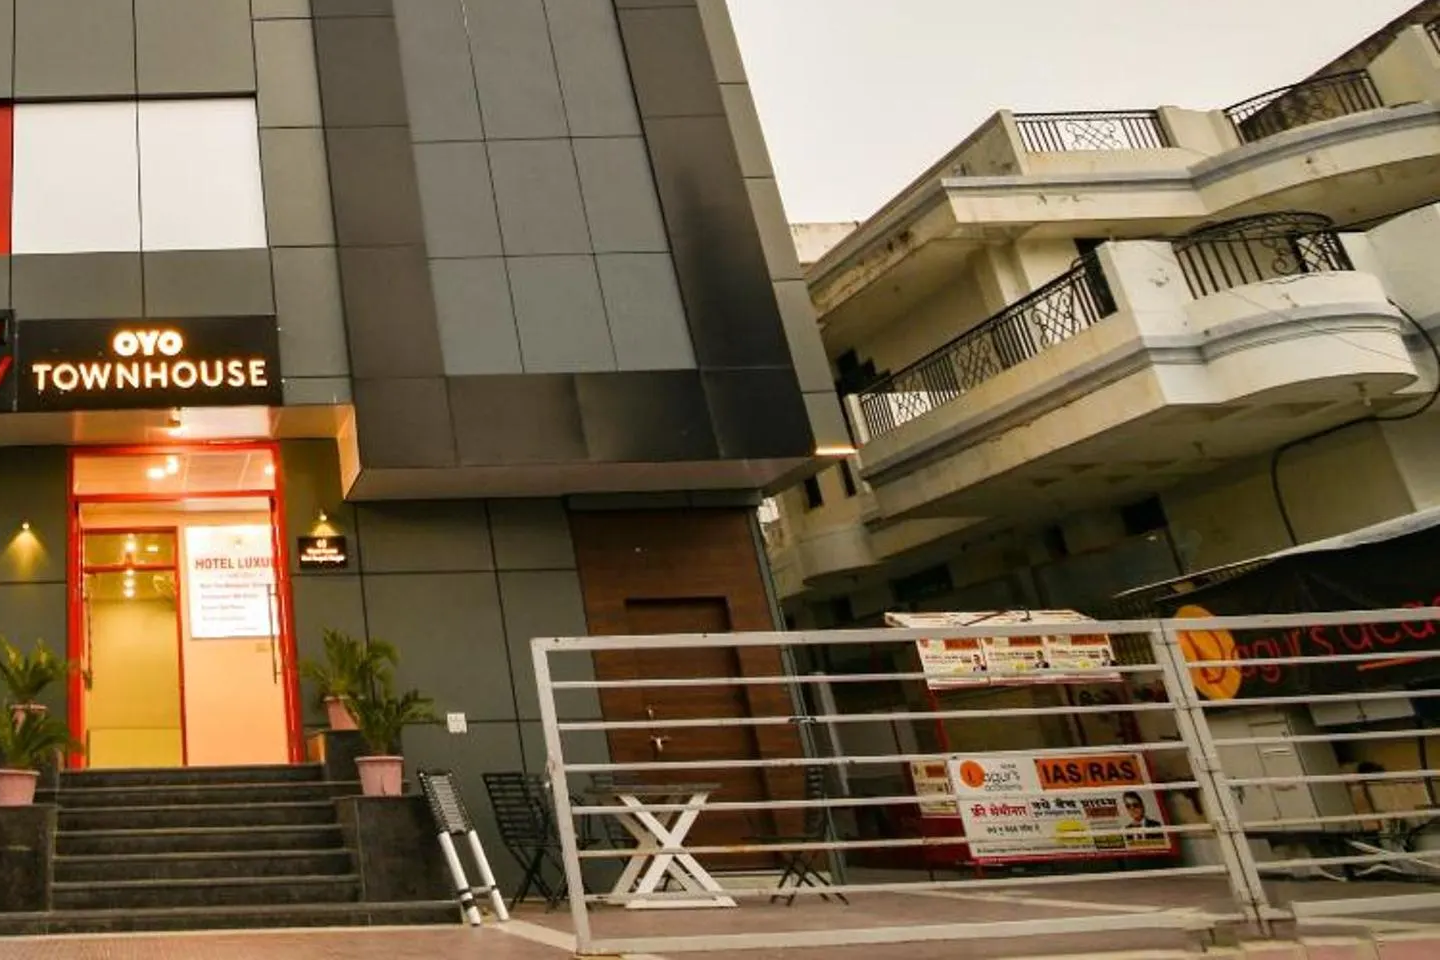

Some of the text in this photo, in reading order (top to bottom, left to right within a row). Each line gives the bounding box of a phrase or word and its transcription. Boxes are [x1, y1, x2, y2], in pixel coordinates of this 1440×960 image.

[112, 329, 184, 356] OYO
[31, 359, 268, 392] TOWNHOUSE
[195, 555, 274, 570] HOTEL LUXU
[1338, 596, 1440, 650] aca
[1041, 760, 1138, 785] IAS/RAS
